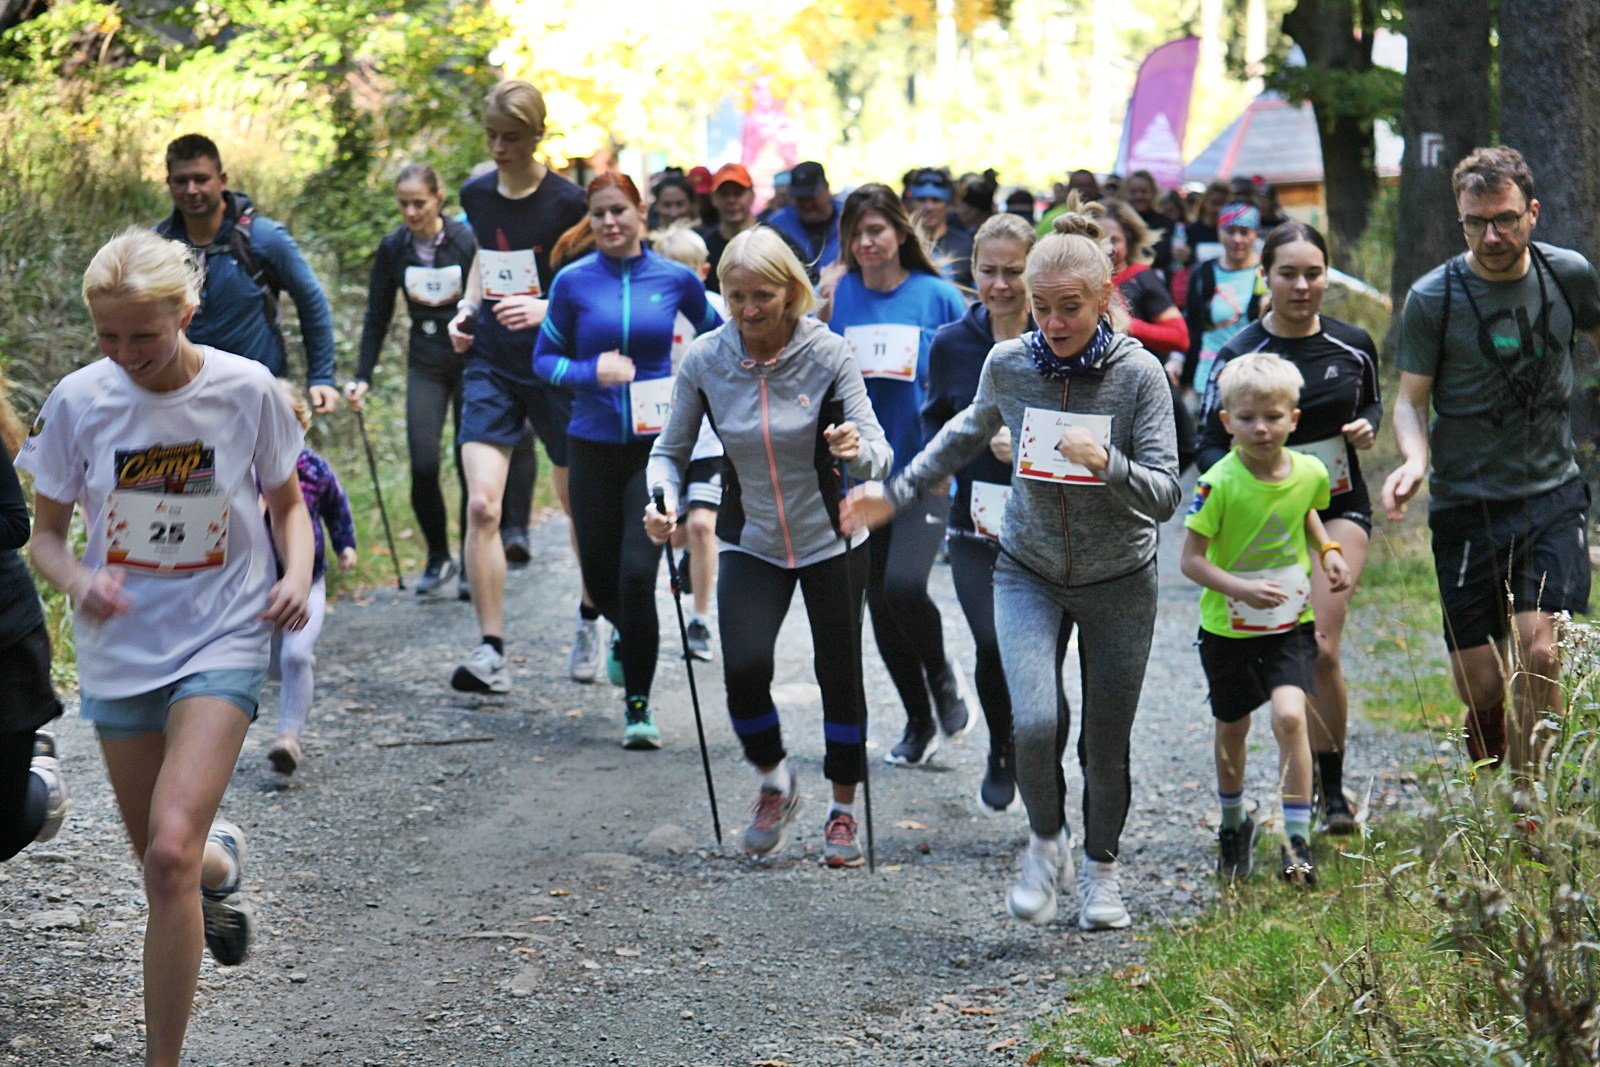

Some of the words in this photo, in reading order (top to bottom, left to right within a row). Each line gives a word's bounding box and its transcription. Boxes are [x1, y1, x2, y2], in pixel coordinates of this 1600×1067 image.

[498, 269, 513, 281] 41
[873, 343, 887, 356] 11
[655, 402, 670, 415] 17
[120, 452, 202, 484] Camp
[149, 521, 185, 544] 25
